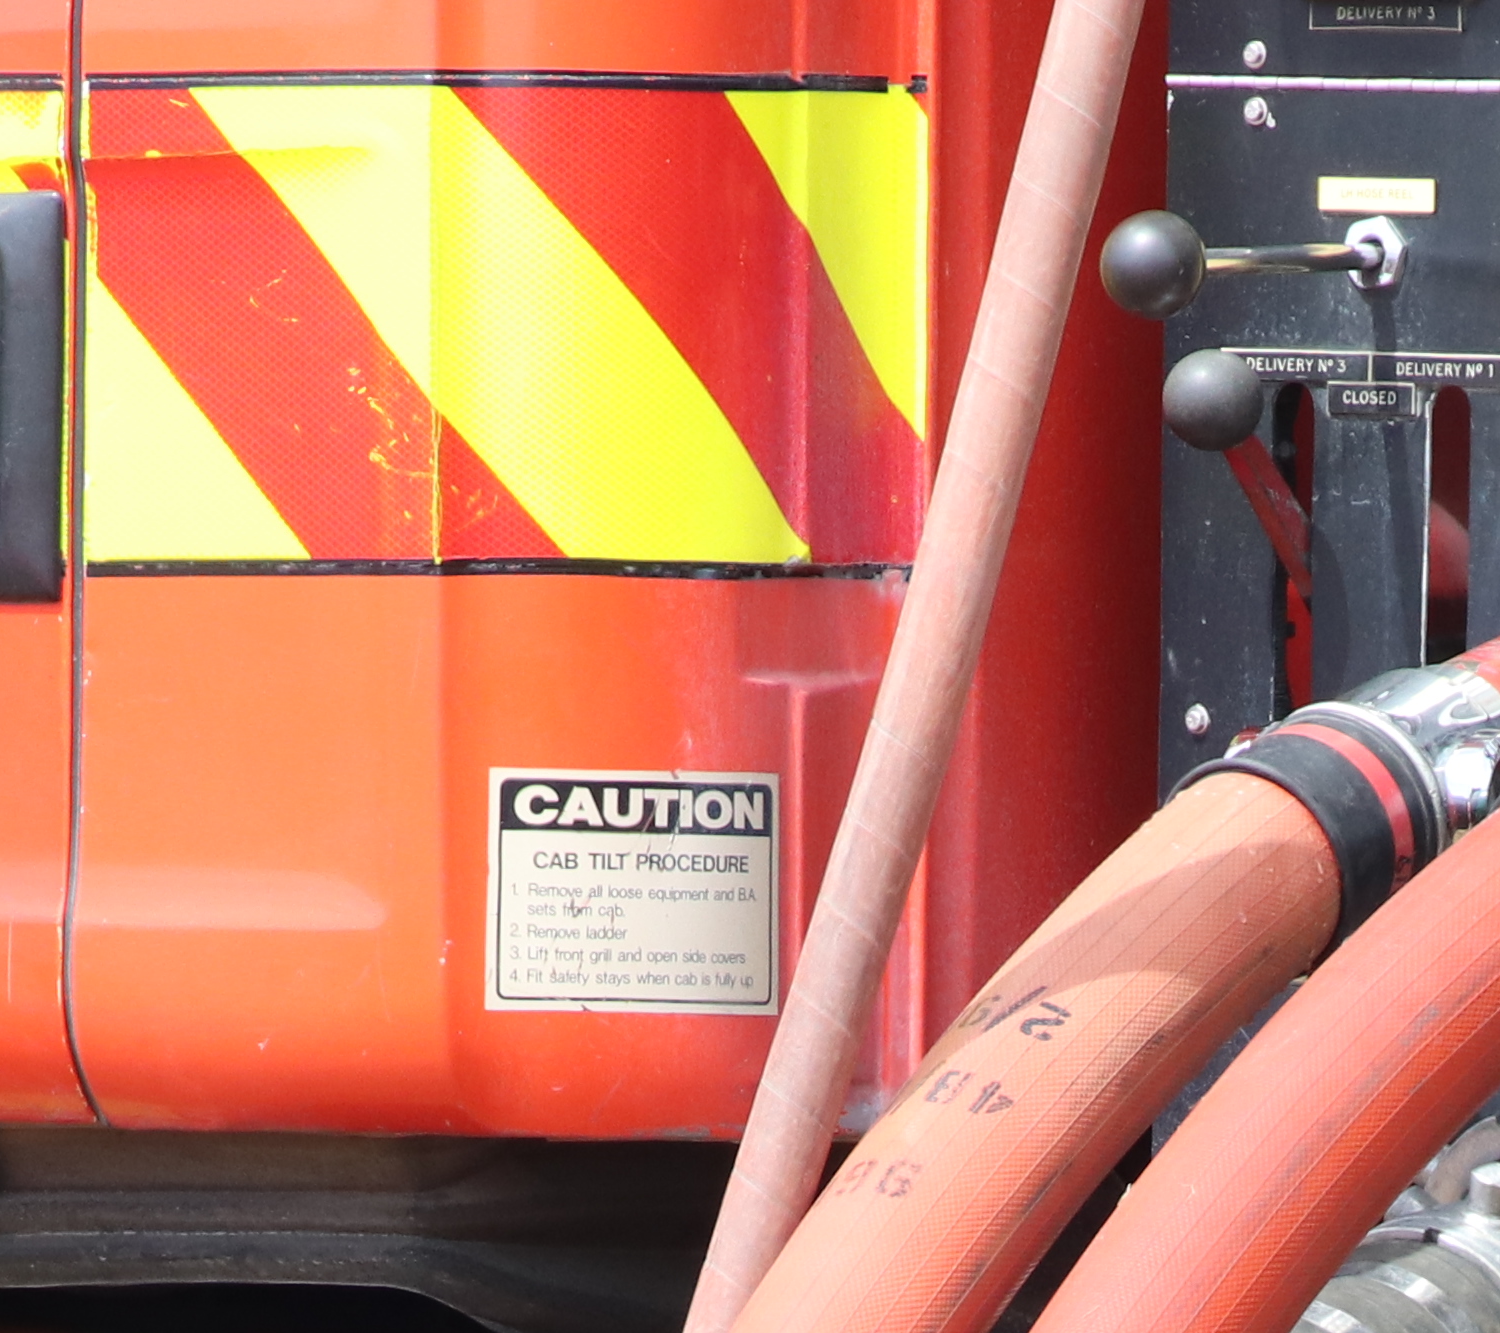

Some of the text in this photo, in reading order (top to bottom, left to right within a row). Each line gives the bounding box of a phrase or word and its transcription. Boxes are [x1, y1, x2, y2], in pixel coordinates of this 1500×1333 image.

[1336, 5, 1437, 20] DELIVERY 3
[1356, 188, 1384, 200] HOSE
[1246, 357, 1348, 373] DELIVERY 3
[1395, 361, 1463, 378] DELIVERY
[1341, 389, 1398, 406] CLOSED
[512, 783, 765, 831] CAUTION
[533, 851, 750, 874] CAB TILT PROCEDURE
[527, 883, 735, 903] Remove all loose equipment and
[526, 902, 626, 918] sets from cab.
[509, 923, 628, 941] 2. Remove ladder
[509, 945, 747, 965] 3. Lift front grill and open side covers
[509, 969, 755, 990] 4. Fit safety stays when cab is fully up
